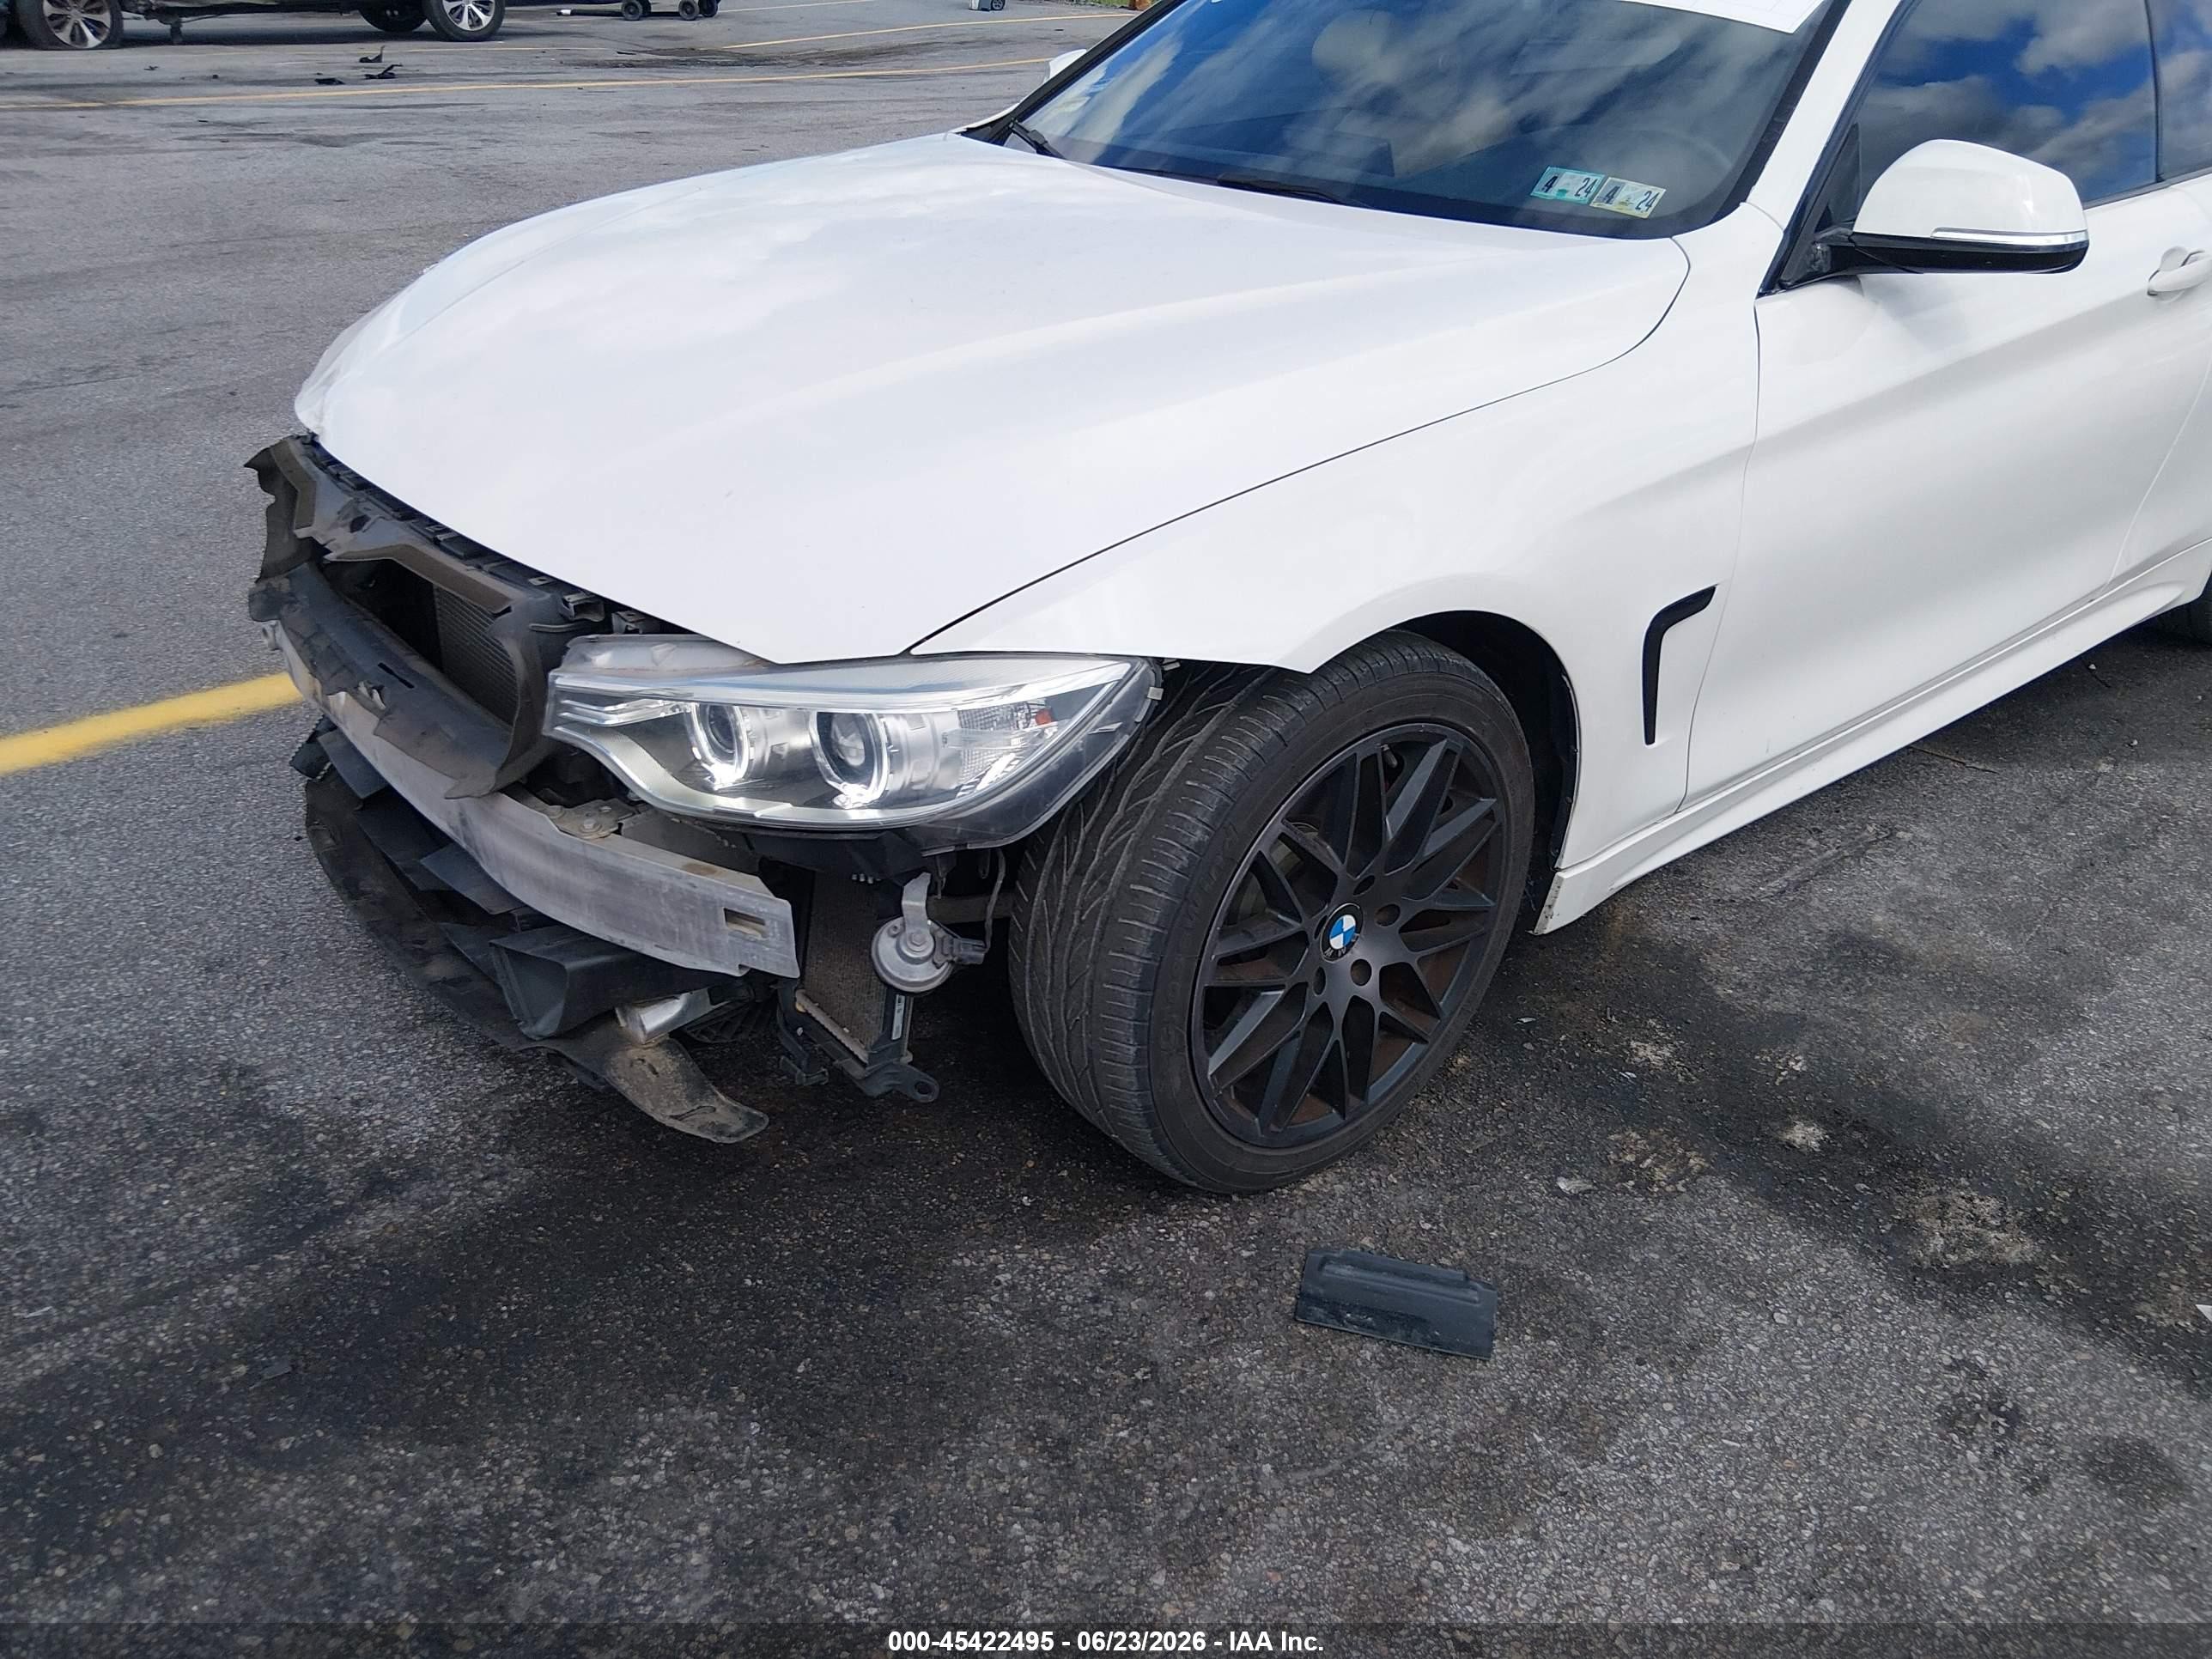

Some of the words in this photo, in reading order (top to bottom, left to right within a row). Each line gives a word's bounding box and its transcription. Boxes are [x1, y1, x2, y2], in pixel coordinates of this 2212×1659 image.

[1541, 175, 1559, 193] 4
[1574, 177, 1598, 198] 24
[1603, 185, 1620, 205] 4
[1635, 190, 1661, 212] 24
